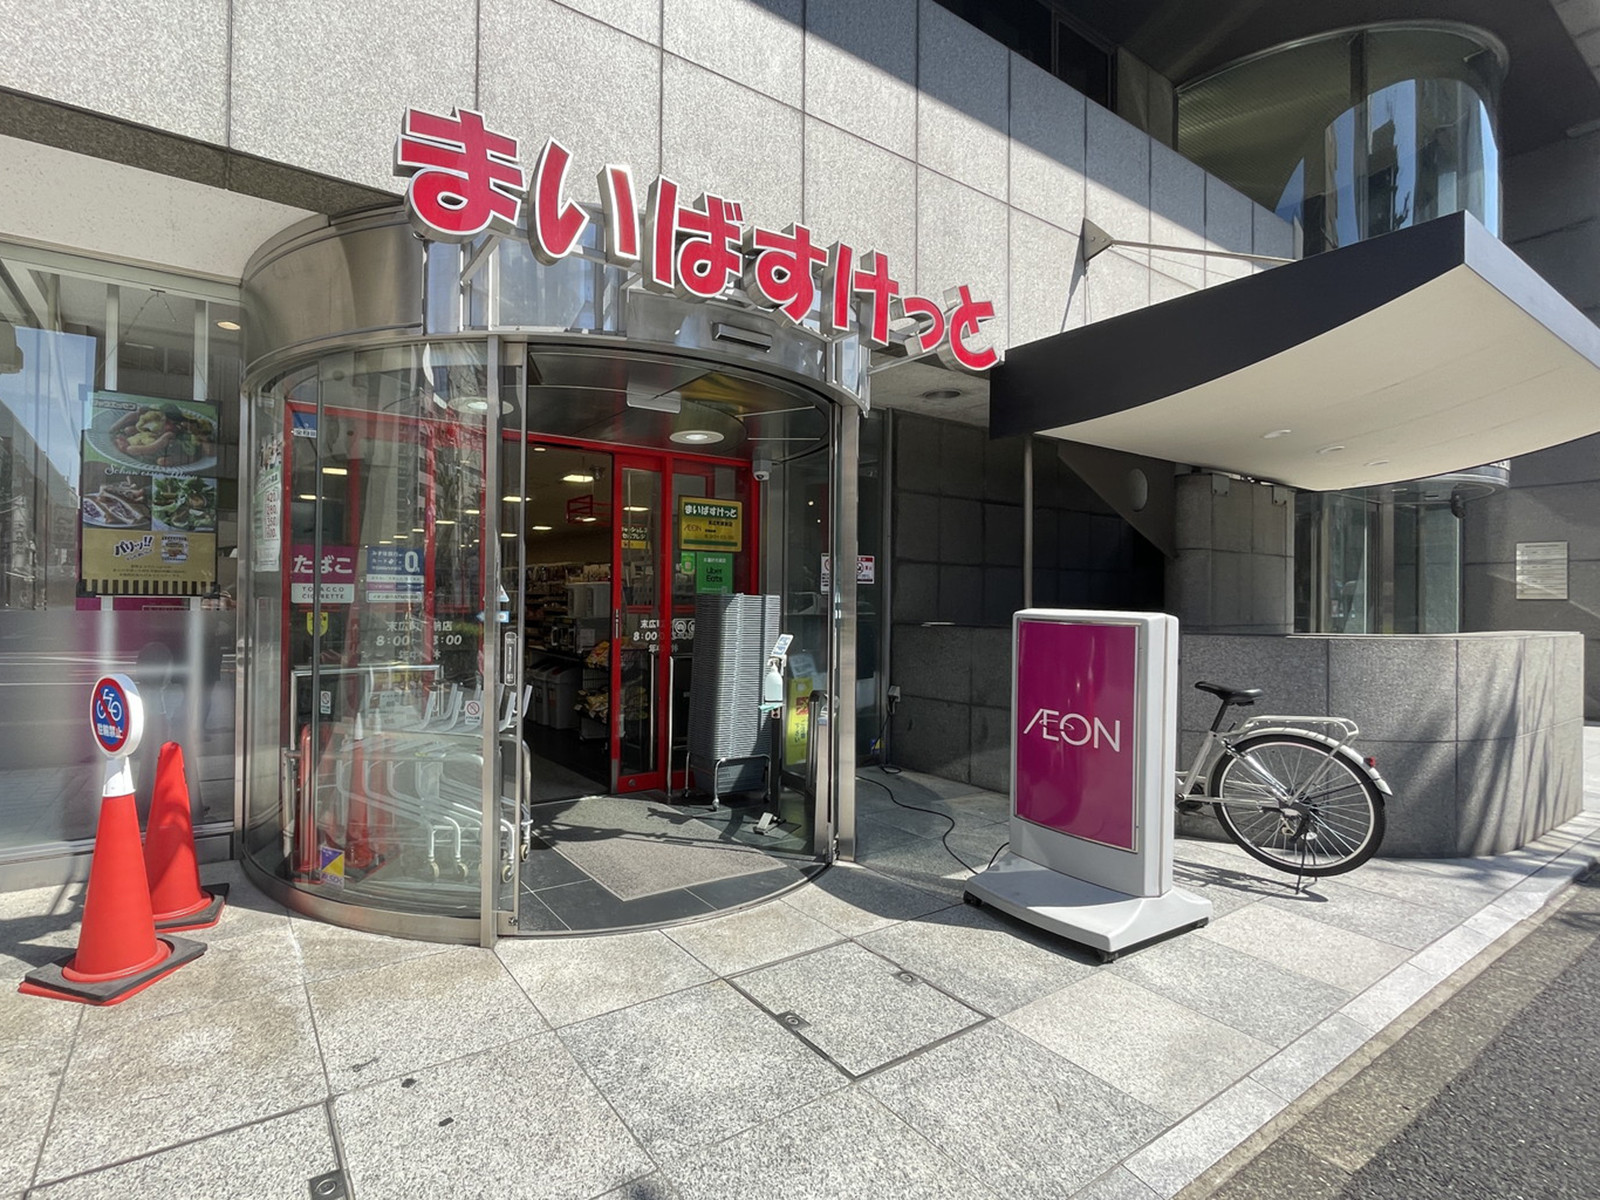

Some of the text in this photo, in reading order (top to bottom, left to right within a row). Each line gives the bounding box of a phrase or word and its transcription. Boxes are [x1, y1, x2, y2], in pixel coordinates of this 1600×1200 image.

[394, 106, 1003, 371] まいばすけっと
[685, 504, 737, 518] まいばすけっと
[294, 555, 352, 574] たばこ
